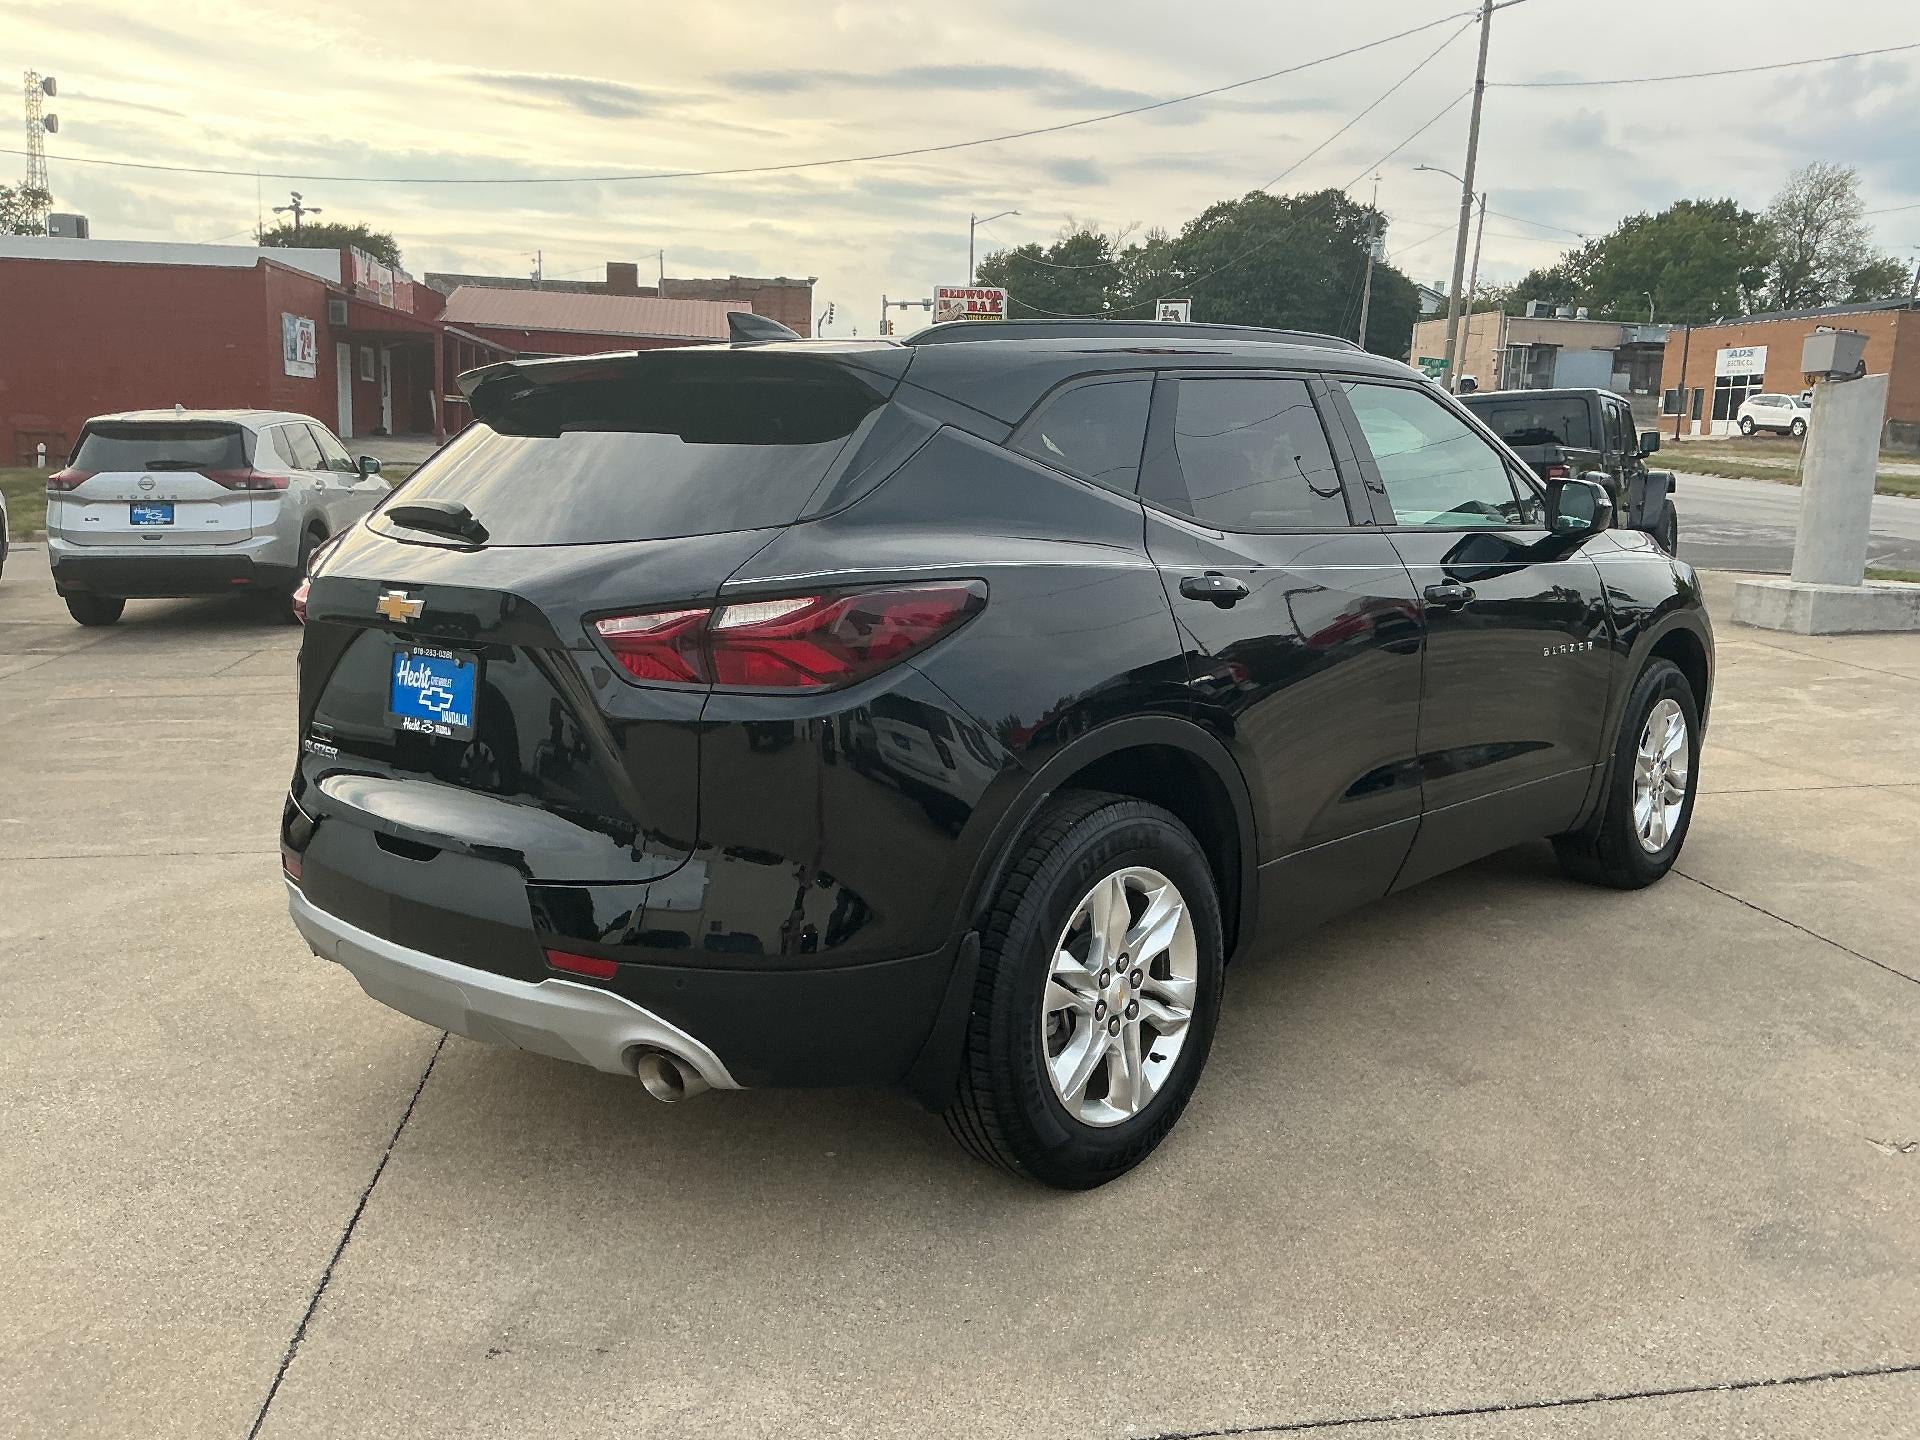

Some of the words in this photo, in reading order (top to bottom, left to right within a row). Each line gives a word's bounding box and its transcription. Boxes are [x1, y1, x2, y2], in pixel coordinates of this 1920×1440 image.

[939, 288, 1003, 301] REDWOOD
[966, 299, 1003, 313] BAR
[1729, 349, 1754, 358] ADS
[1543, 641, 1593, 657] BLAZER
[397, 659, 432, 690] Hecht
[402, 716, 421, 731] Hecht
[441, 709, 469, 727] VANDALIA
